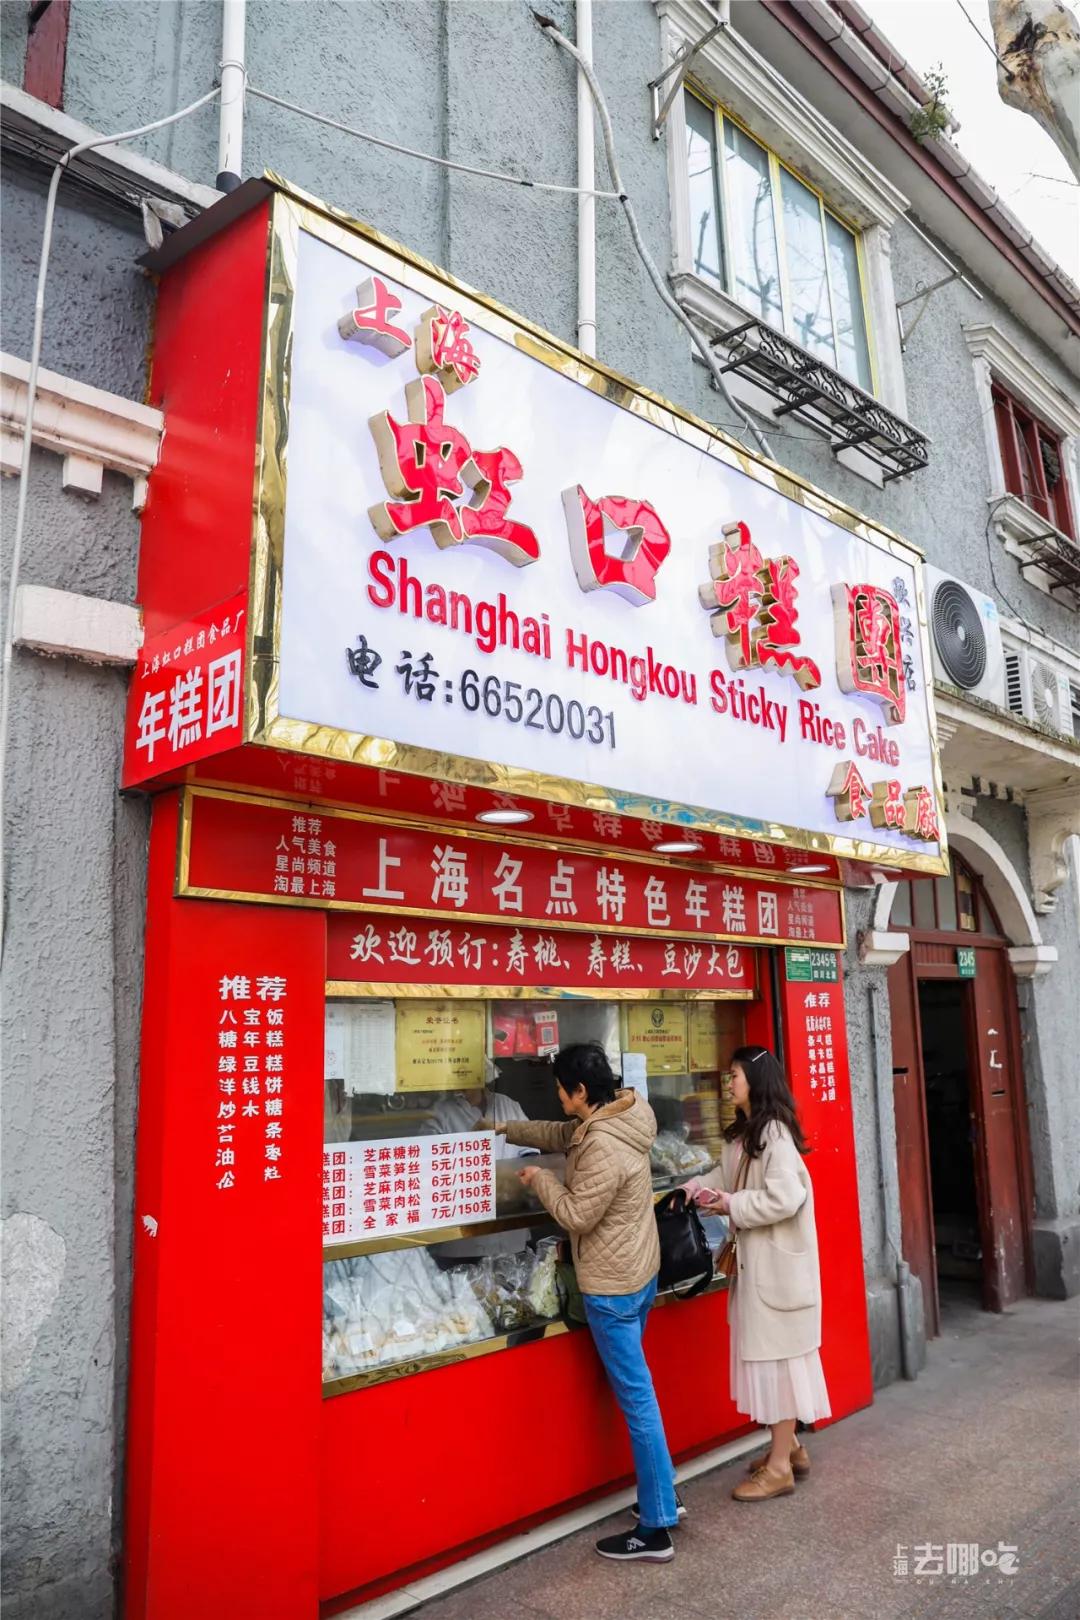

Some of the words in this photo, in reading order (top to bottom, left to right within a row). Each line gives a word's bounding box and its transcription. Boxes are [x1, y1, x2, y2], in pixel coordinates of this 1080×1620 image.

[345, 276, 481, 388] 上海
[367, 550, 551, 659] Shanghai
[566, 628, 697, 705] Hongkou
[709, 669, 788, 742] Sticky
[797, 697, 846, 751] Rice
[852, 717, 900, 767] Cake
[135, 648, 242, 763] 年糕团
[291, 815, 322, 835] 推荐
[275, 834, 337, 858] 人气美食
[275, 854, 336, 877] 星尚频道
[274, 875, 336, 897] 淘最上海
[362, 838, 778, 937] 上海名点特色年糕团
[811, 952, 838, 967] 2345号
[219, 975, 287, 1001] 推荐
[804, 991, 831, 1008] 推荐
[219, 1009, 284, 1026] 八宝饭
[218, 1030, 284, 1049] 糖年糕
[218, 1054, 283, 1074] 绿豆糕
[218, 1076, 283, 1096] 洋钱饼
[363, 1145, 421, 1162] 芝麻糖粉
[431, 1138, 491, 1155] 5元/150克
[363, 1161, 421, 1179] 雪菜笋丝
[431, 1153, 491, 1171] 5元/150克
[363, 1177, 421, 1195] 芝麻肉松
[431, 1169, 491, 1187] 6元/150克
[363, 1193, 421, 1212] 雪菜肉松
[431, 1184, 491, 1203] 6元/150克
[431, 1200, 491, 1219] 7元/150克
